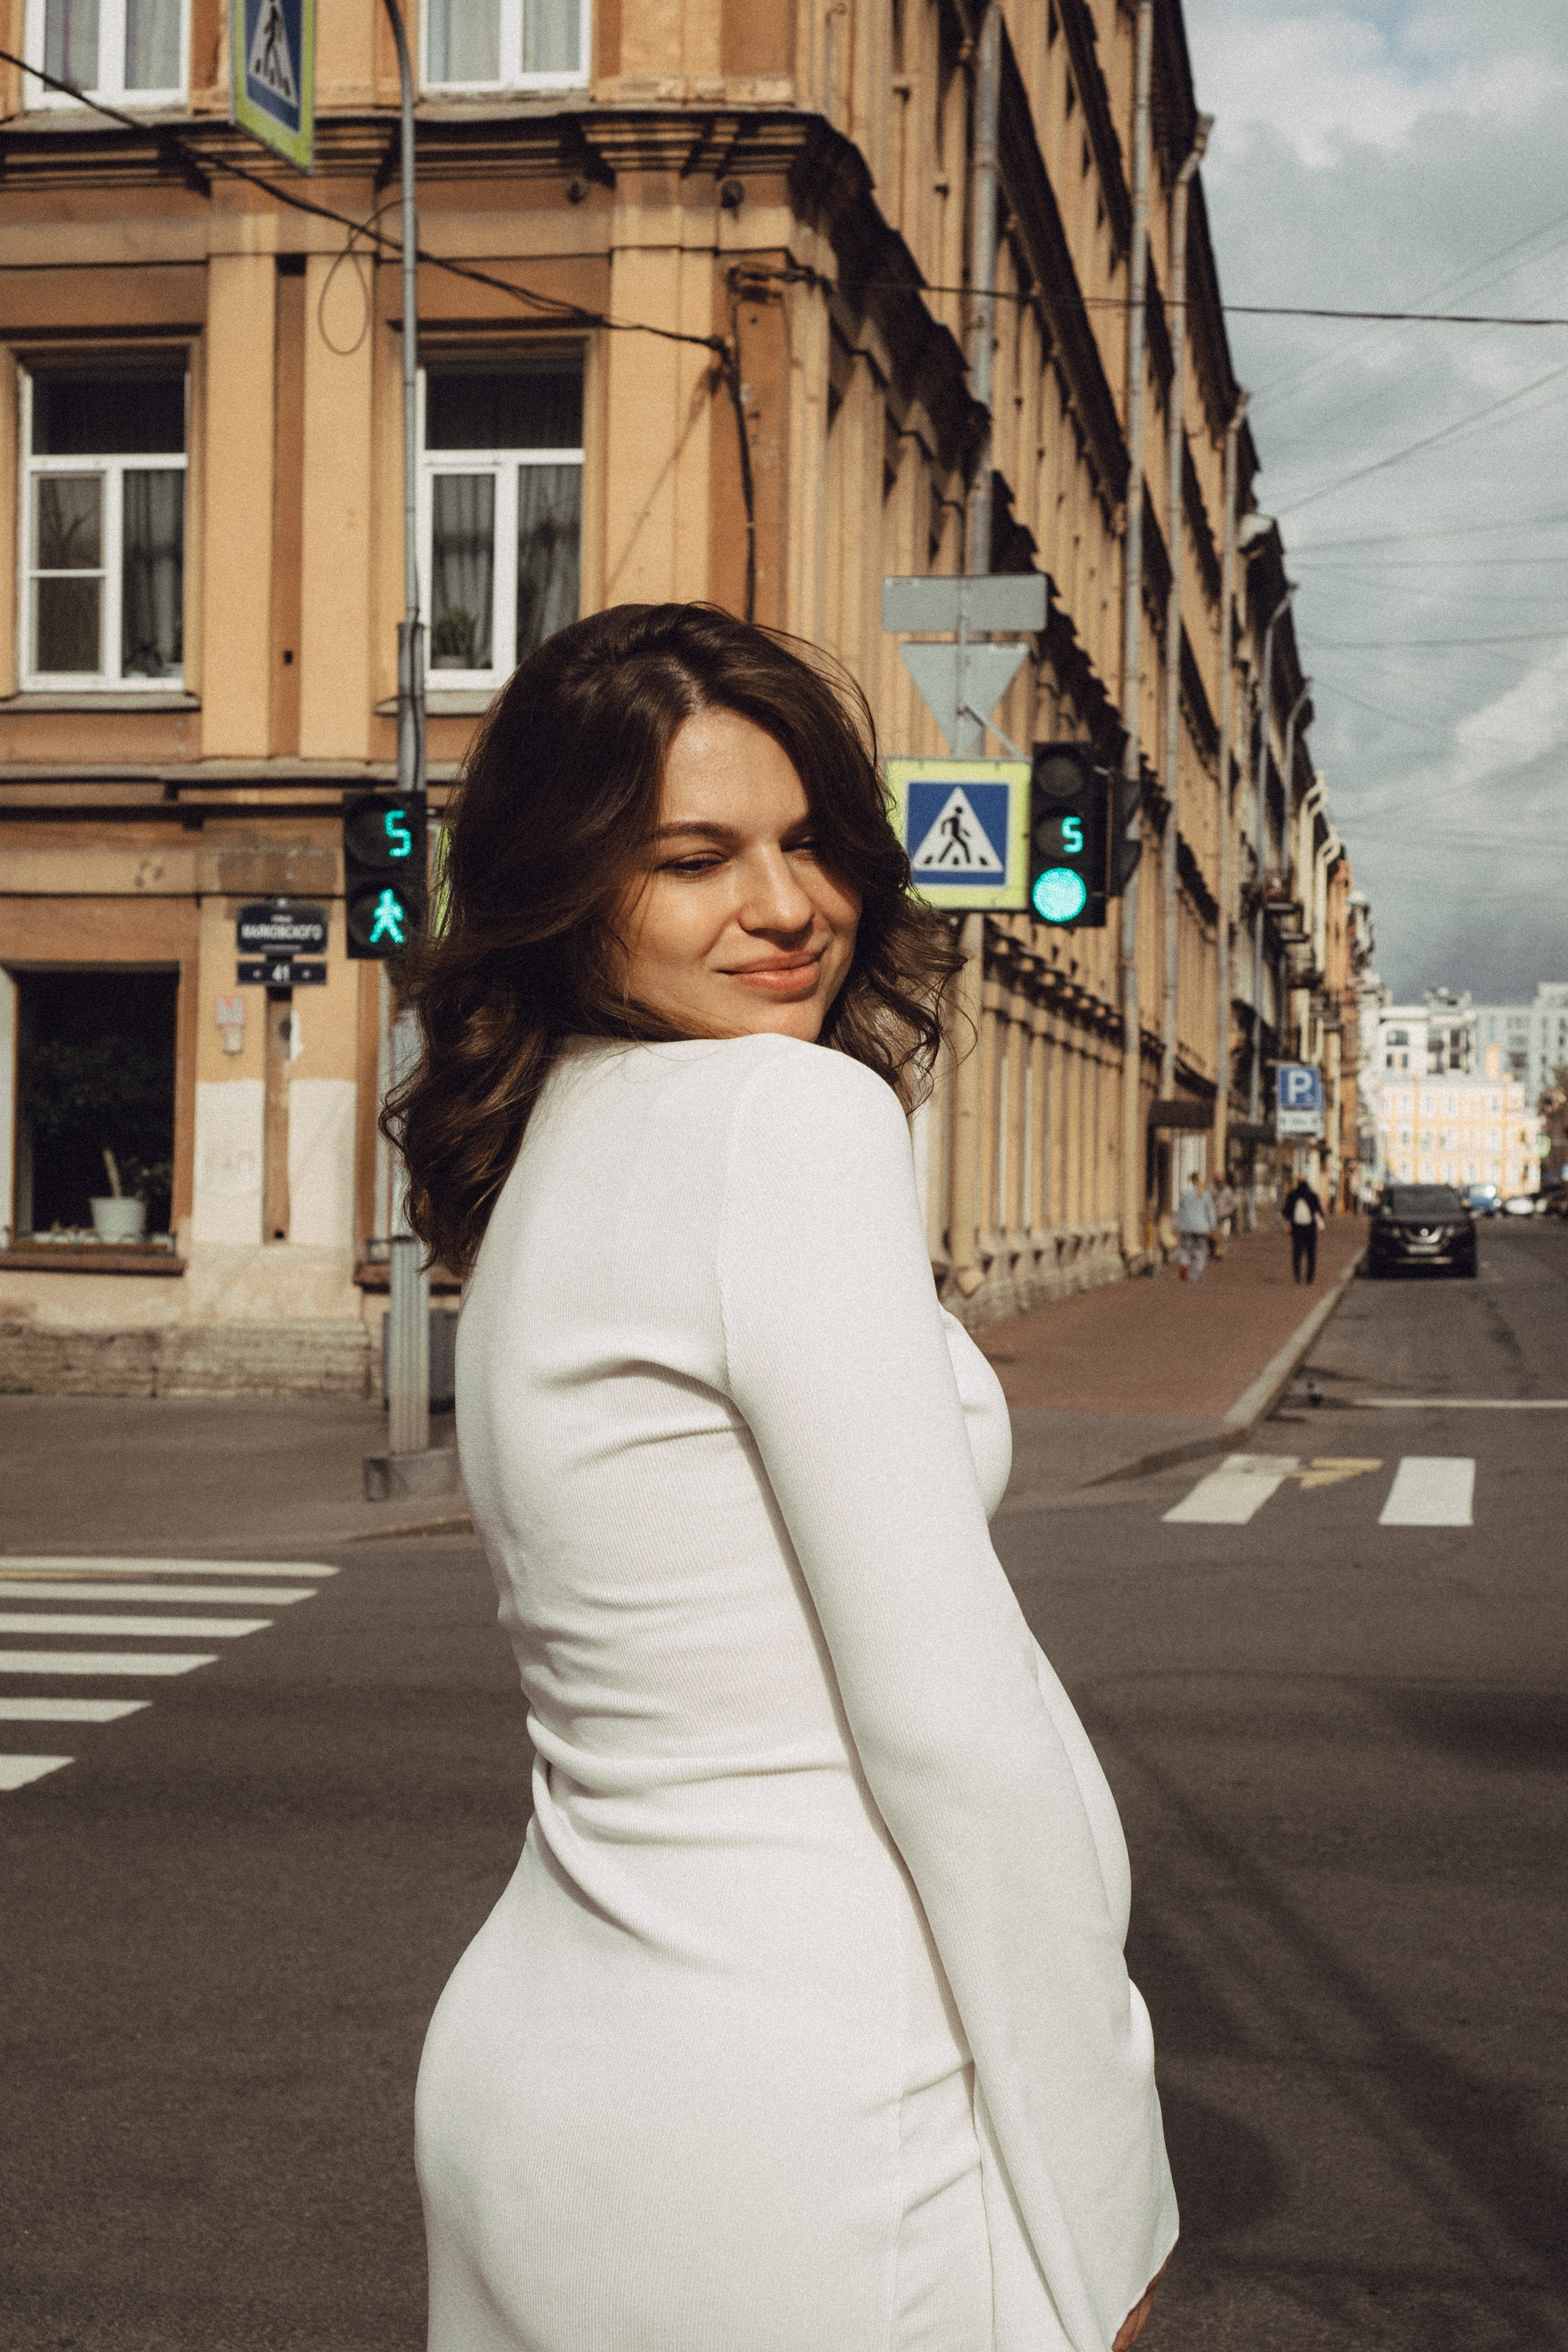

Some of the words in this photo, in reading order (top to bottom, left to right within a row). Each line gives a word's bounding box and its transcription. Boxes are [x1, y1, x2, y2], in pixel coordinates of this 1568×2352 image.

[385, 810, 412, 857] 5
[1061, 816, 1084, 853] 5
[272, 964, 290, 982] 41
[1287, 1069, 1313, 1103] P
